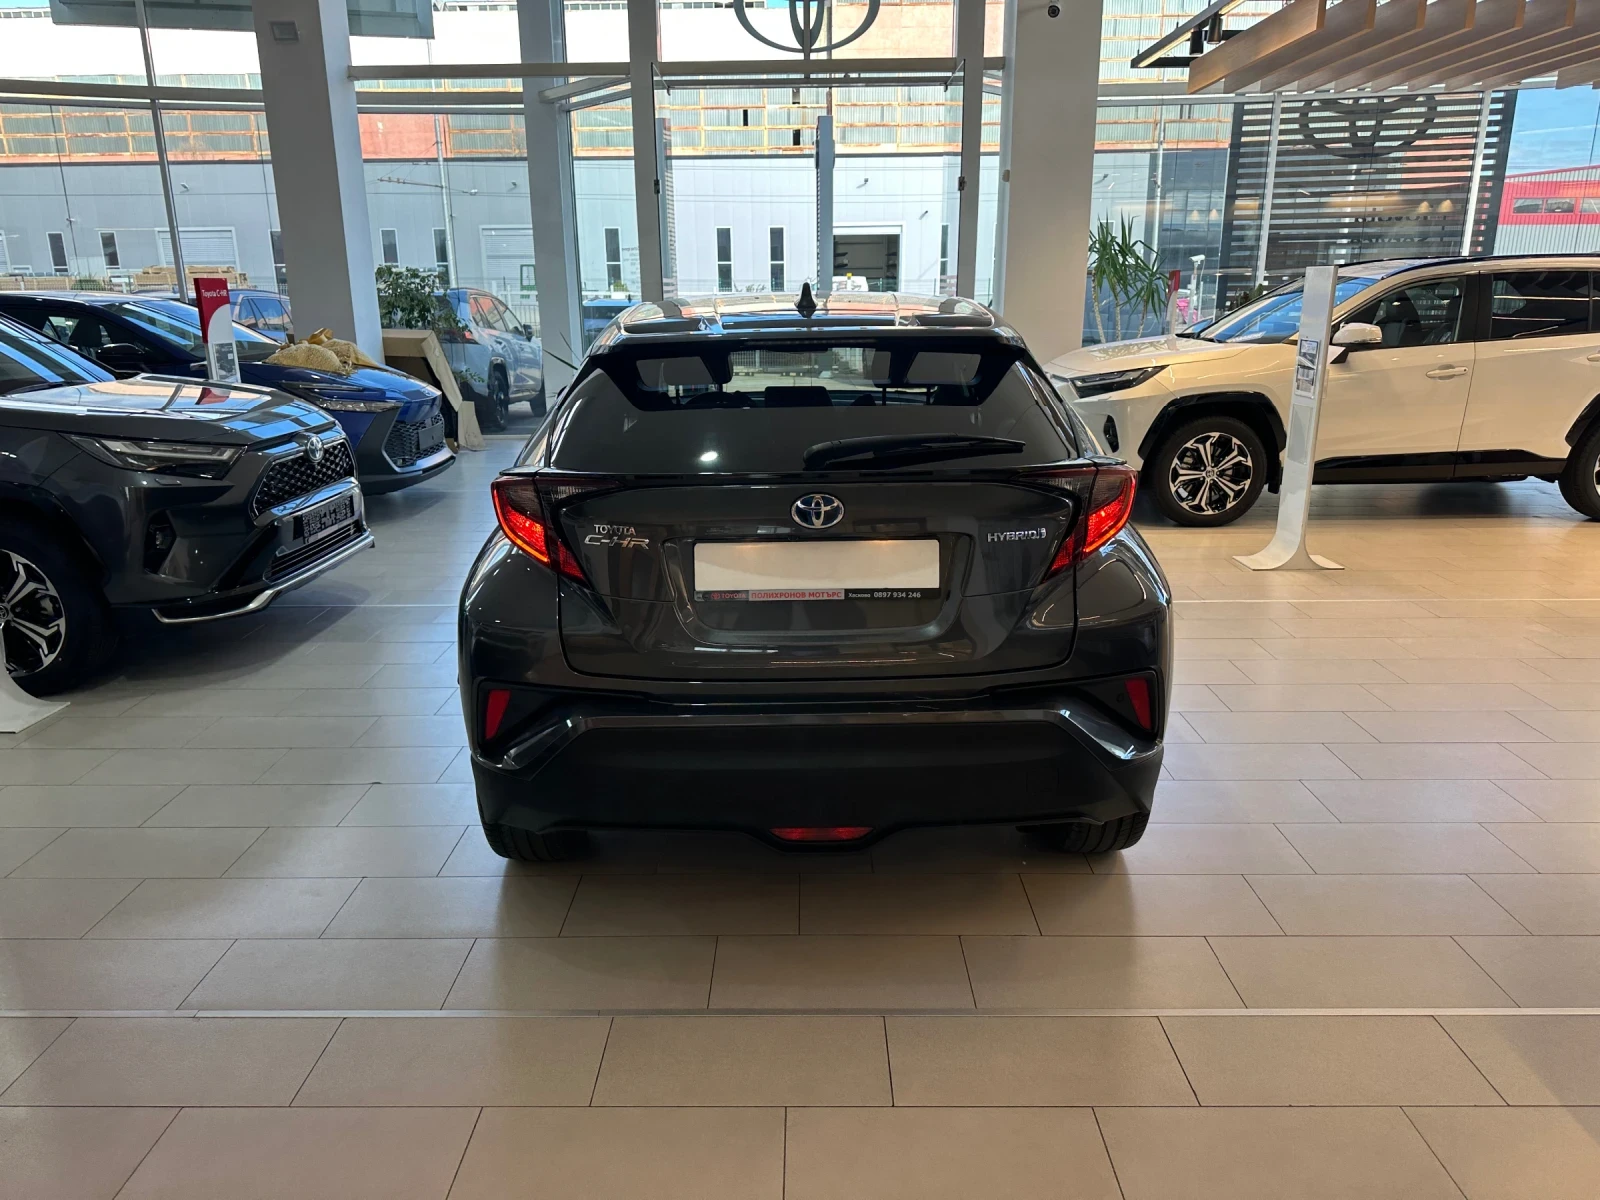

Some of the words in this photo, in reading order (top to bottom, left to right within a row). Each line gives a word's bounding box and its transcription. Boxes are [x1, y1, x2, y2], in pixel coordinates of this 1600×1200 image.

[202, 290, 216, 298] Toyota
[216, 289, 227, 297] C-HR
[594, 524, 636, 535] TOYOTA
[584, 534, 650, 549] C-HR
[987, 530, 1038, 542] HYBRID
[751, 591, 807, 599] ПОЛИХРОНОВ
[808, 591, 842, 599] МОТЪРС
